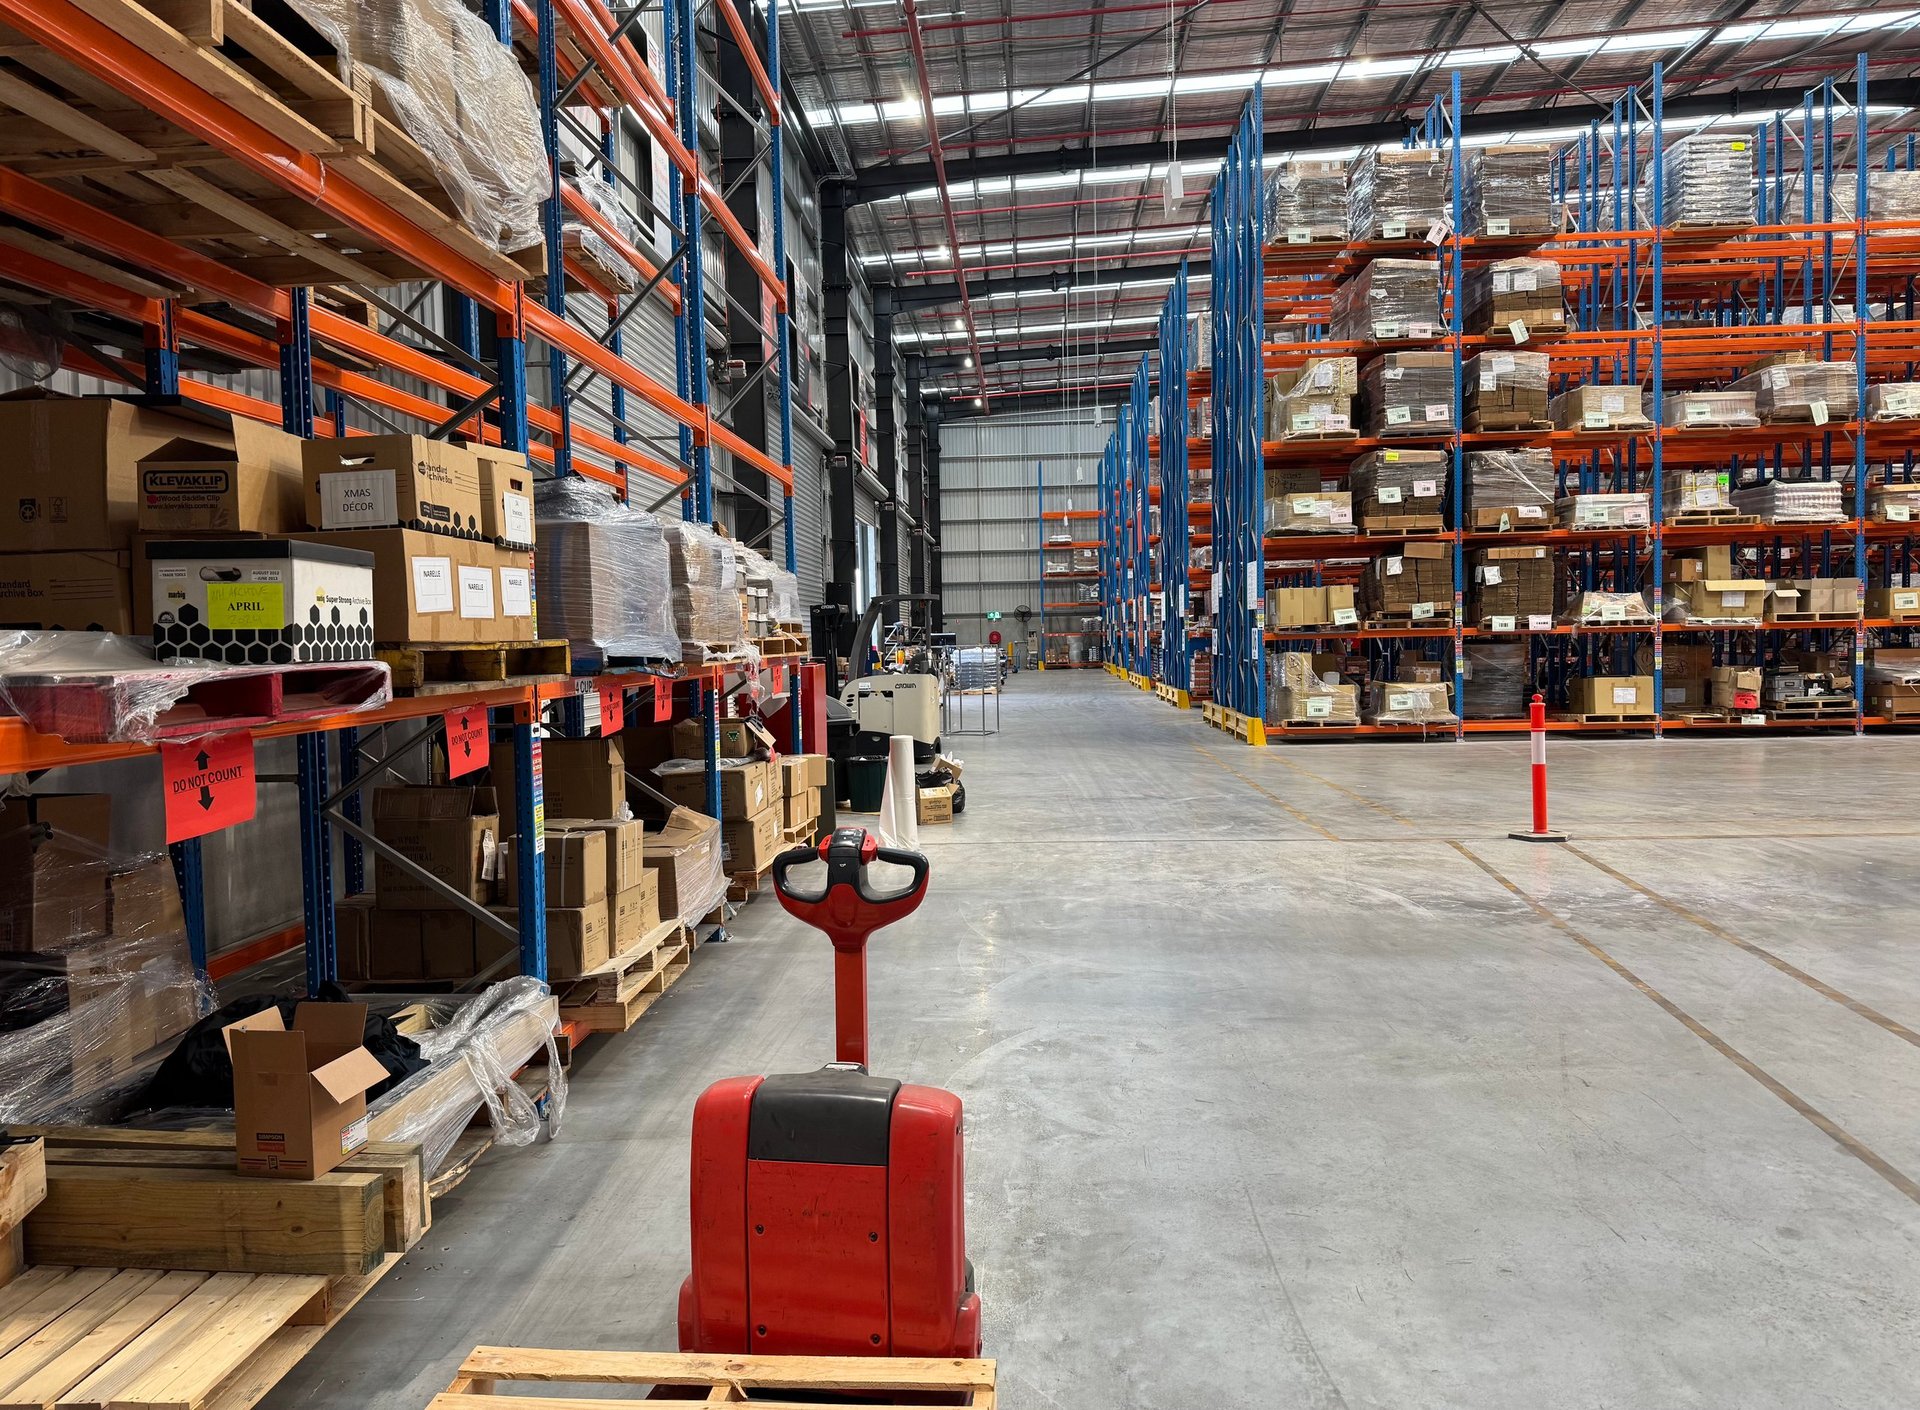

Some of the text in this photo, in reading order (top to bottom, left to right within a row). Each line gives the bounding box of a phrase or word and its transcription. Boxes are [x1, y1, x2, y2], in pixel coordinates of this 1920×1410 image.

[149, 474, 223, 486] KLEVAKLIP
[343, 488, 371, 498] XMAS
[206, 494, 221, 503] Clip
[342, 501, 374, 512] DÉCOR
[423, 570, 441, 578] NARELLE
[468, 583, 484, 591] NARELLE
[0, 588, 26, 598] rchive
[168, 590, 186, 600] marbig
[326, 595, 338, 604] Super
[338, 596, 352, 606] Strong
[227, 602, 265, 611] APRIL
[581, 680, 593, 693] CUP
[451, 728, 483, 745] DO NOT COUNT
[173, 766, 243, 793] DO NOT COUNT
